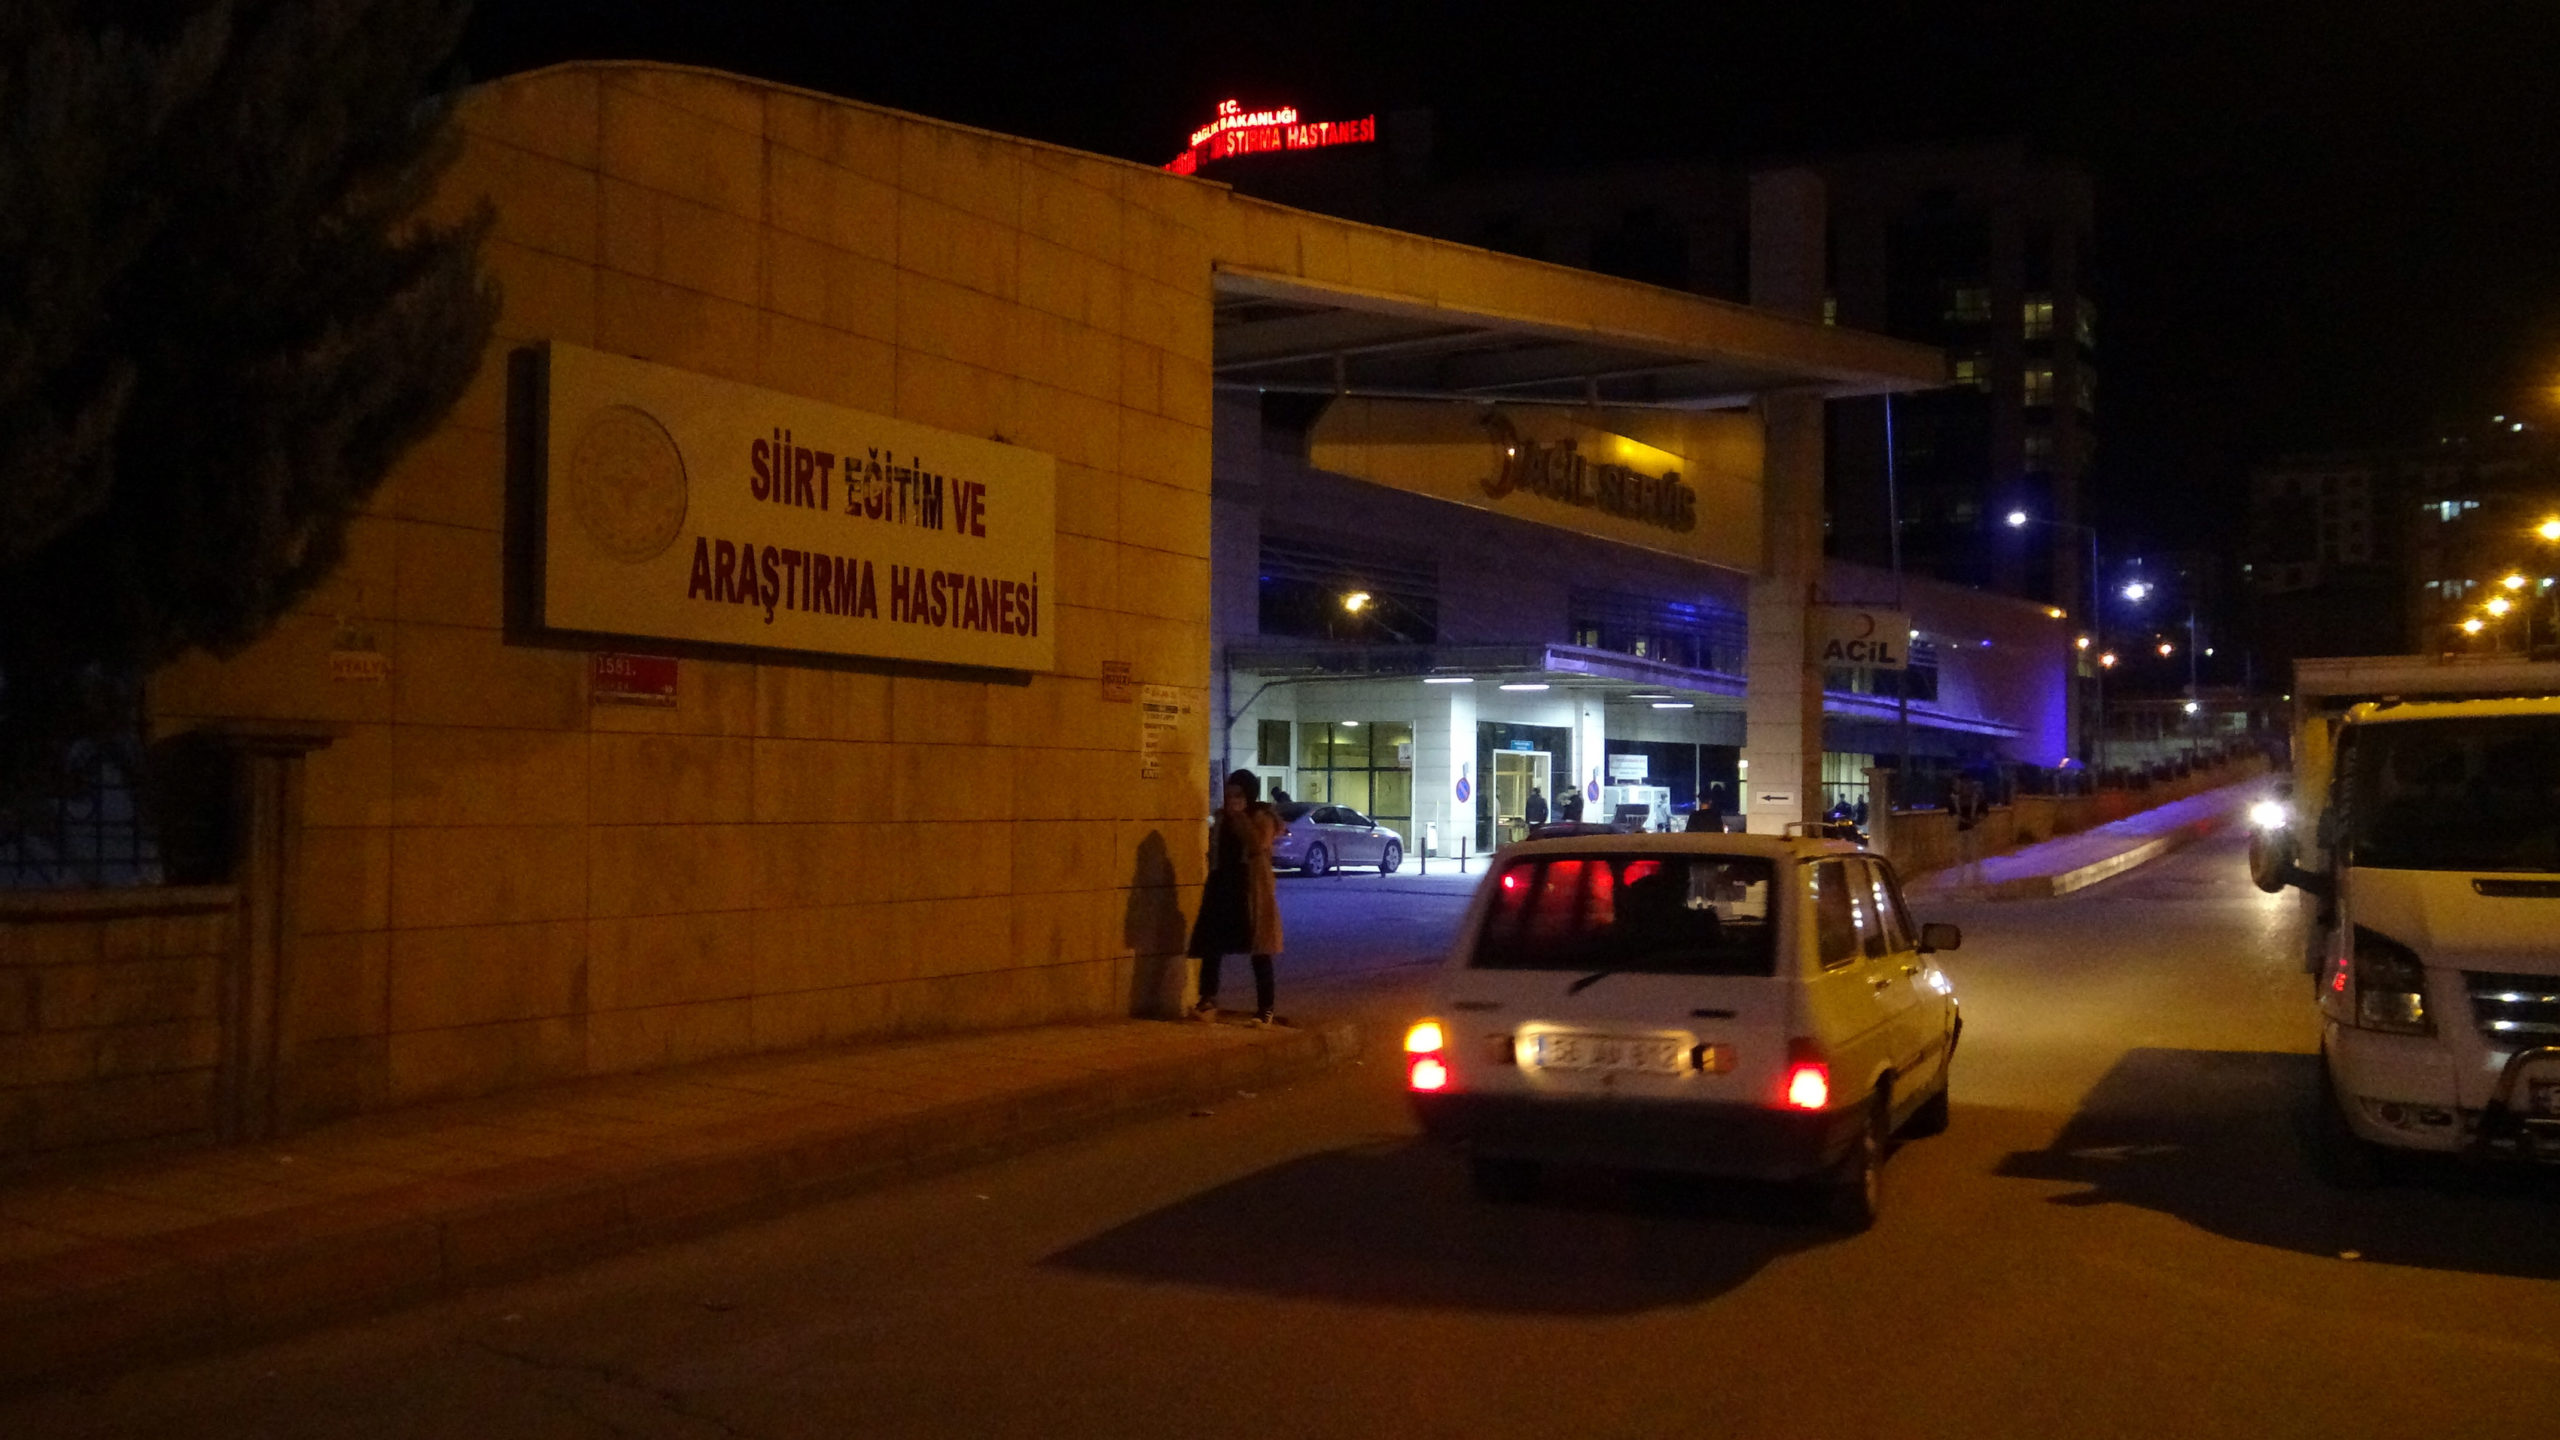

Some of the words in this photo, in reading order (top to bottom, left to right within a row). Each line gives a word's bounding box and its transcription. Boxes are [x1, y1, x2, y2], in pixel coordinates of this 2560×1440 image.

[1219, 107, 1297, 131] BAKANLIĞI
[1287, 114, 1375, 150] HASTANESİ
[750, 427, 835, 511] SİİRT
[844, 447, 943, 531] EĞİTİM
[951, 477, 986, 538] VE
[687, 536, 878, 625] ARAŞTIRMA
[890, 564, 1038, 638] HASTANESİ
